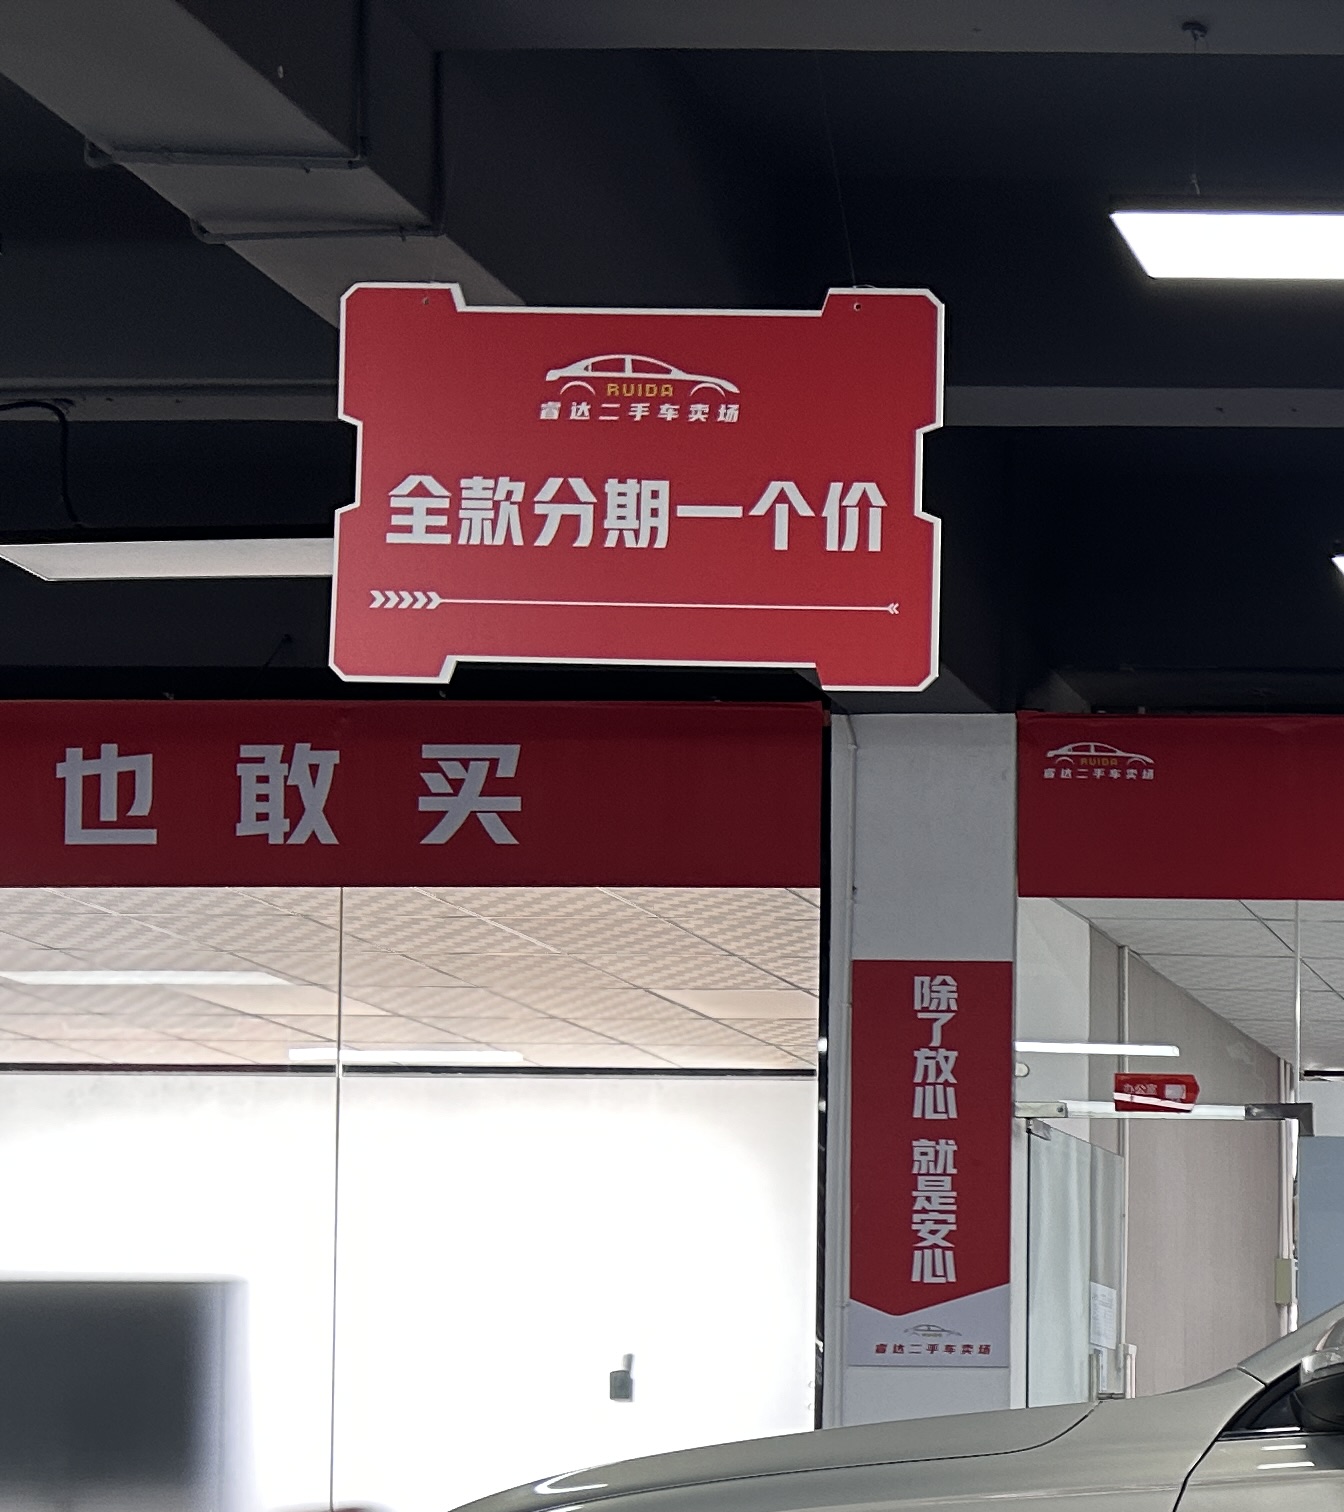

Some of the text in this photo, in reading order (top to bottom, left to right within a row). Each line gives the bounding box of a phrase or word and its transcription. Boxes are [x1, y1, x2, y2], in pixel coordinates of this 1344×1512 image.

[539, 401, 740, 423] 睿达二手车卖场
[606, 383, 674, 397] RUIDA
[385, 474, 888, 552] 全款分期一个价
[55, 742, 523, 846] 也敢买
[912, 975, 959, 1120] 除了放心
[911, 1138, 958, 1284] 就是安心
